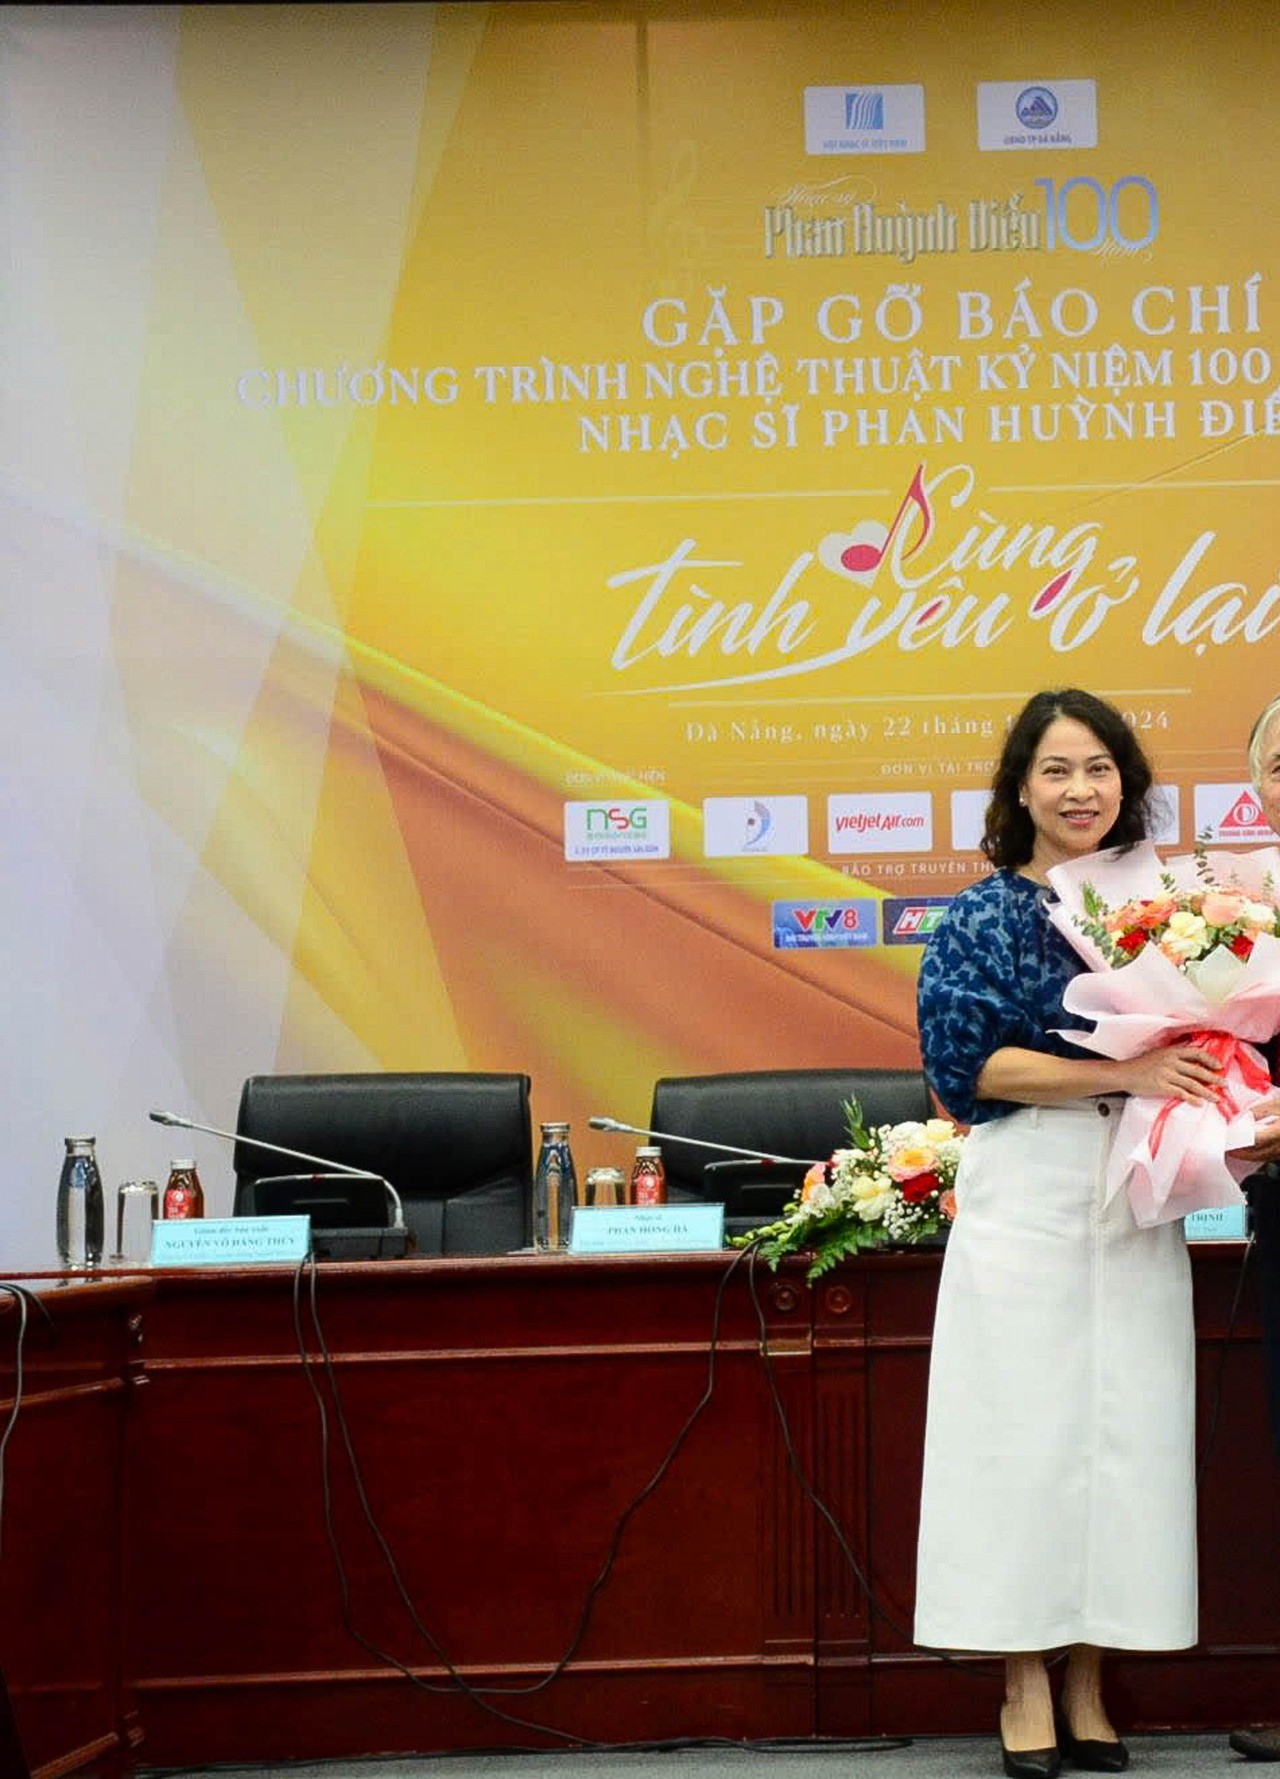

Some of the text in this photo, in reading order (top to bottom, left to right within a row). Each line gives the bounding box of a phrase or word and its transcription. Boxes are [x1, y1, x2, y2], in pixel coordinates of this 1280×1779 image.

[1034, 174, 1160, 252] 100
[642, 272, 1263, 359] GẶP GỠ BÁO CHÍ
[237, 363, 459, 408] CHƯƠNG
[474, 355, 628, 403] TRÌNH
[643, 352, 783, 405] NGHỆ
[797, 348, 963, 402] THUẬT
[977, 343, 1037, 391] KỶ
[1050, 344, 1173, 396] NIỆM
[1189, 347, 1272, 386] 100
[578, 410, 729, 461] NHẠC
[750, 403, 801, 450] SĨ
[822, 406, 965, 448] PHAN
[988, 394, 1177, 443] HUỲNH
[890, 462, 1104, 610] Cùng
[606, 538, 818, 671] tình
[685, 720, 719, 743] Đà
[812, 718, 872, 743] ngày
[882, 715, 913, 737] 22
[921, 713, 994, 738] tháng
[1121, 709, 1171, 731] 024
